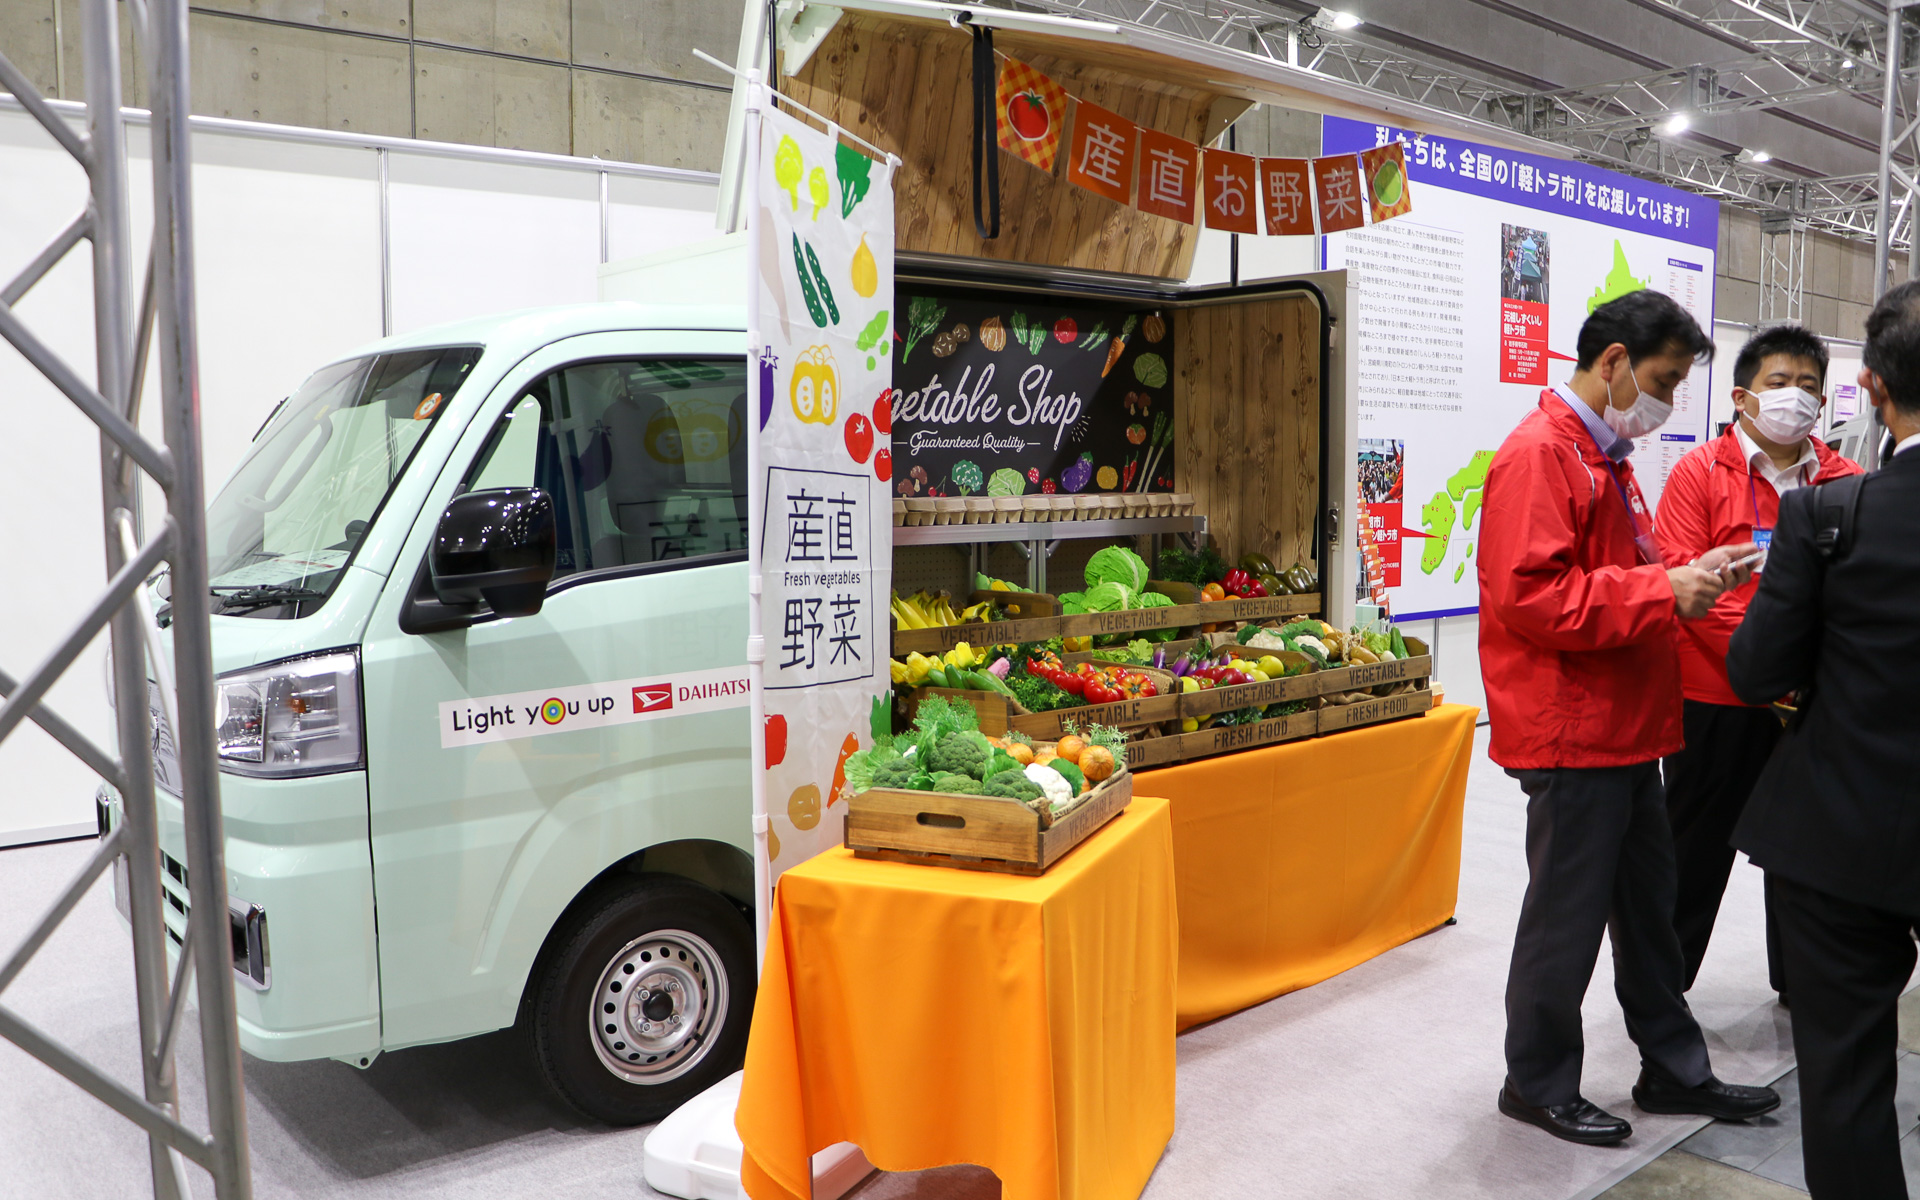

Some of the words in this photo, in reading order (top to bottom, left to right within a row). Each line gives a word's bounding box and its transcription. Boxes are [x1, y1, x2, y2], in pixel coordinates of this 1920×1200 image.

[1077, 120, 1358, 226] 産直お野菜
[1503, 322, 1526, 336] 軽トラ市
[891, 363, 1001, 425] getable
[1007, 364, 1082, 451] Shop
[910, 430, 981, 456] Guaranteed
[982, 432, 1025, 454] Quality
[785, 487, 858, 563] 産直
[784, 571, 811, 587] Fresh
[814, 569, 861, 588] vegetables
[1097, 610, 1168, 632] VEGETABLE
[1233, 597, 1293, 618] VEGETABLE
[780, 593, 861, 670] 野菜
[940, 623, 1022, 647] VEGETABLE
[1349, 662, 1406, 686] VEGETABLE
[1219, 681, 1287, 709] VEGETABLE
[452, 704, 516, 734] Light
[525, 696, 580, 726] you
[588, 696, 615, 716] up
[1057, 702, 1141, 732] VEGETABLE
[1346, 705, 1379, 725] FRESH
[1383, 698, 1408, 715] FOOD
[1214, 726, 1253, 750] FRESH
[1258, 720, 1289, 741] FOOD
[1128, 745, 1145, 764] OD
